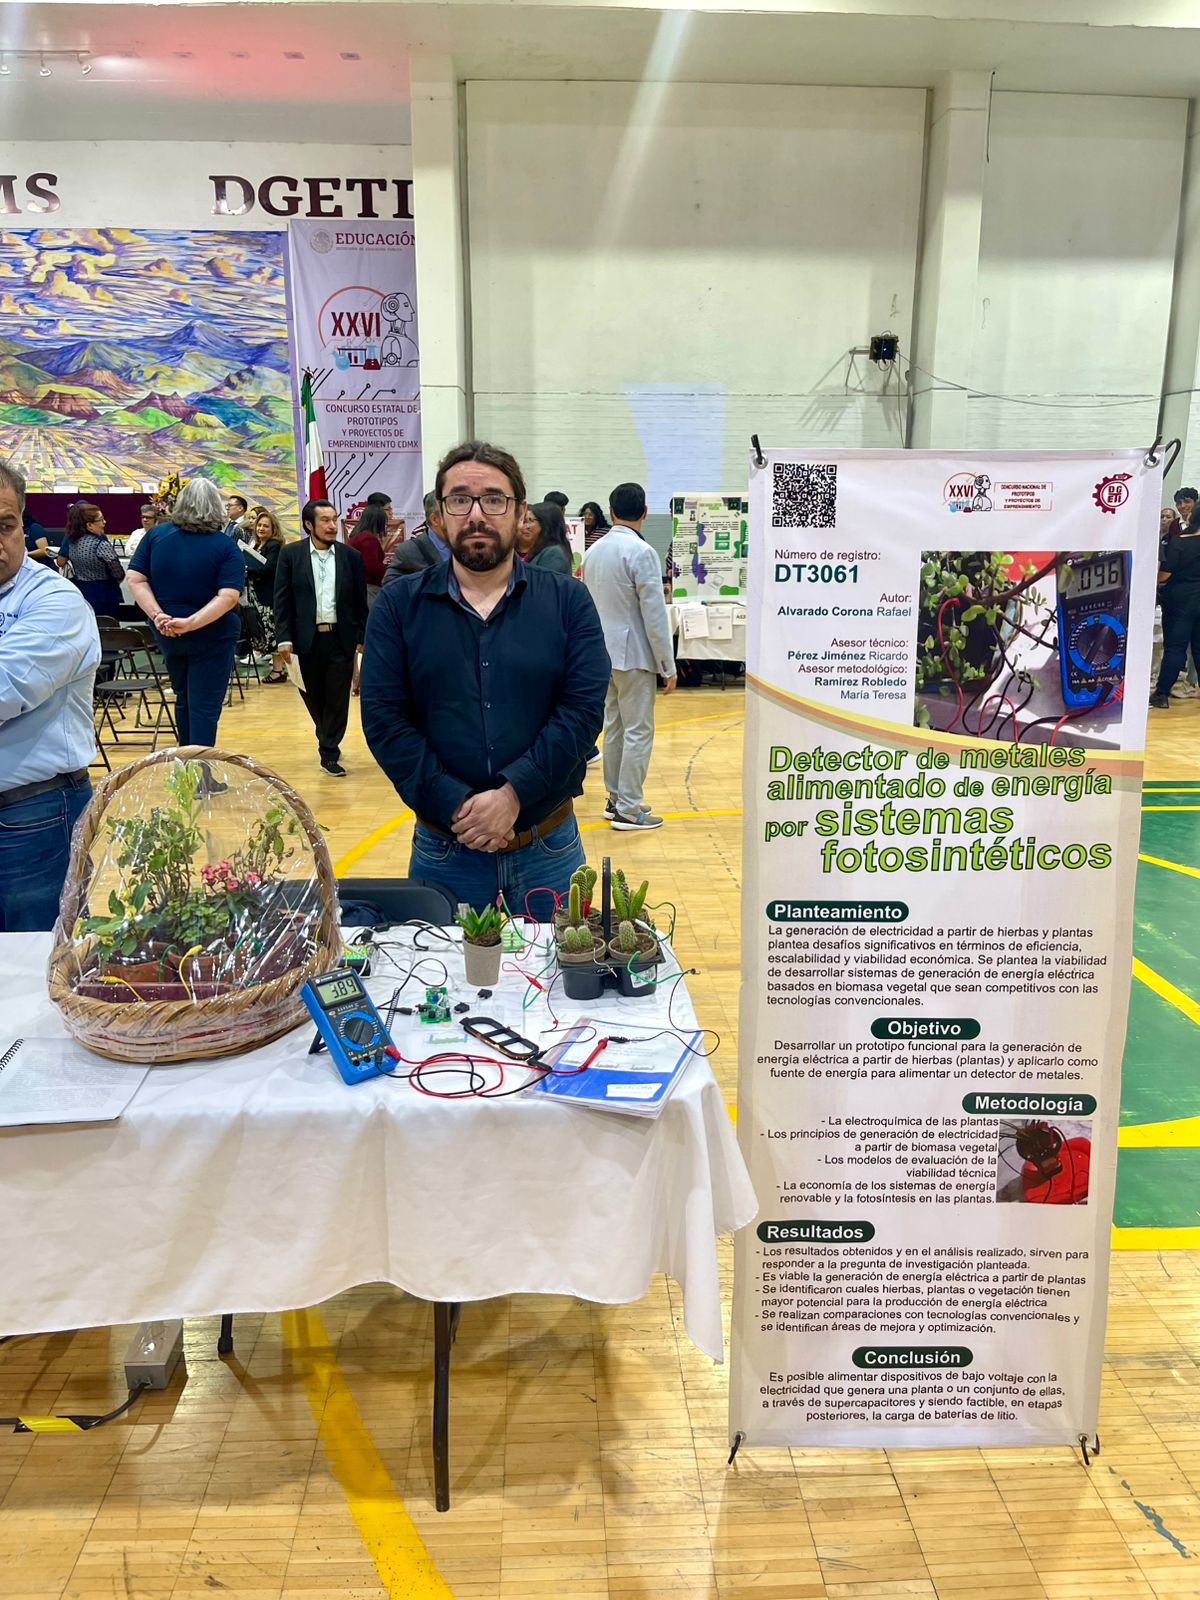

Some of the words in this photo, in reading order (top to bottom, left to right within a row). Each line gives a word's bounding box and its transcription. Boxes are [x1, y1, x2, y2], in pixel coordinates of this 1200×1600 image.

[209, 175, 414, 219] DGETI
[331, 312, 382, 337] XXVI
[326, 404, 370, 413] CONCURSO
[372, 404, 405, 413] ESTATAL
[407, 405, 417, 413] DE
[347, 417, 398, 425] PROTOTIPOS
[342, 428, 347, 436] Y
[348, 428, 392, 437] PROYECTOS
[394, 429, 404, 437] DE
[328, 440, 396, 448] EMPRENDIMIENTO
[397, 440, 418, 448] CDMX
[949, 485, 974, 498] XXVI
[774, 549, 816, 559] Número
[820, 550, 833, 560] de
[837, 550, 880, 562] registro:
[775, 564, 858, 583] DT3061
[879, 593, 911, 602] Autor:
[777, 606, 828, 616] Alvarado
[831, 606, 872, 616] Corona
[877, 606, 911, 616] Rafael
[831, 638, 866, 647] Asesor
[869, 638, 908, 647] técnico:
[788, 650, 818, 660] Pérez
[820, 650, 865, 660] Jiménez
[869, 651, 908, 660] Ricardo
[798, 664, 834, 673] Asesor
[837, 664, 907, 675] metodológico:
[862, 677, 906, 686] Robledo
[840, 690, 869, 699] María
[872, 690, 906, 699] Teresa
[770, 746, 908, 772] Detector
[916, 747, 950, 769] de
[960, 744, 1086, 769] metales
[767, 774, 946, 801] alimentado
[954, 777, 984, 797] de
[992, 769, 1112, 802] energía
[765, 818, 809, 842] por
[815, 801, 1014, 836] sistemas
[821, 837, 1112, 873] fotosintéticos
[774, 905, 903, 920] Planteamiento
[769, 925, 782, 935] La
[786, 925, 848, 937] generación
[852, 926, 866, 935] de
[869, 926, 933, 936] electricidad
[937, 928, 943, 936] a
[947, 926, 976, 938] partir
[979, 926, 993, 936] de
[997, 926, 1038, 937] hierbas
[1042, 929, 1049, 939] y
[1052, 927, 1093, 939] plantas
[768, 939, 809, 951] plantea
[812, 939, 860, 949] desafíos
[864, 939, 936, 952] significativos
[939, 942, 953, 950] en
[956, 940, 1005, 950] términos
[1008, 941, 1022, 951] de
[1026, 941, 1081, 952] eficiencia,
[767, 995, 830, 1007] tecnologías
[834, 995, 923, 1005] convencionales.
[888, 1021, 961, 1038] Objetivo
[774, 1040, 835, 1050] Desarrollar
[839, 1042, 852, 1050] un
[856, 1041, 904, 1052] prototipo
[908, 1040, 957, 1051] funcional
[961, 1043, 985, 1053] para
[989, 1042, 998, 1051] la
[1002, 1042, 1064, 1053] generación
[1067, 1043, 1081, 1052] de
[770, 1067, 804, 1077] fuente
[808, 1068, 822, 1077] de
[825, 1068, 867, 1080] energía
[871, 1070, 895, 1080] para
[899, 1068, 950, 1078] alimentar
[953, 1070, 967, 1078] un
[970, 1068, 1016, 1078] detector
[1018, 1069, 1033, 1079] de
[1036, 1070, 1083, 1079] metales.
[976, 1096, 1082, 1114] Metodología
[864, 1142, 892, 1153] partir
[894, 1142, 908, 1151] de
[911, 1142, 956, 1151] biomasa
[959, 1143, 998, 1154] vegetal
[906, 1168, 955, 1177] viabilidad
[959, 1168, 997, 1178] técnica
[780, 1193, 831, 1203] renovable
[835, 1196, 840, 1205] y
[844, 1193, 853, 1203] la
[856, 1193, 915, 1203] fotosíntesis
[919, 1195, 932, 1203] en
[935, 1194, 950, 1203] las
[954, 1194, 995, 1205] plantas.
[767, 1225, 864, 1239] Resultados
[762, 1259, 815, 1269] responder
[828, 1260, 836, 1268] la
[840, 1259, 886, 1270] pregunta
[888, 1259, 902, 1268] de
[905, 1259, 973, 1271] investigación
[976, 1260, 1029, 1271] planteada.
[761, 1298, 794, 1307] mayor
[797, 1297, 843, 1308] potencial
[846, 1298, 869, 1307] para
[873, 1297, 882, 1306] la
[885, 1297, 942, 1308] producción
[945, 1297, 958, 1306] de
[961, 1299, 1001, 1310] energía
[1005, 1298, 1047, 1308] eléctrica
[776, 1322, 828, 1332] identifican
[831, 1322, 860, 1331] áreas
[864, 1322, 876, 1331] de
[880, 1322, 915, 1333] mejora
[918, 1324, 924, 1333] y
[928, 1322, 995, 1333] optimización.
[864, 1350, 961, 1364] Conclusión
[769, 1372, 783, 1382] Es
[787, 1371, 824, 1383] posible
[827, 1371, 878, 1381] alimentar
[880, 1371, 942, 1383] dispositivos
[945, 1371, 958, 1380] de
[962, 1371, 985, 1382] bajo
[988, 1372, 1023, 1384] voltaje
[1027, 1375, 1045, 1383] con
[1048, 1372, 1057, 1381] la
[760, 1384, 820, 1395] electricidad
[823, 1386, 843, 1396] que
[847, 1387, 884, 1397] genera
[911, 1384, 943, 1396] planta
[956, 1386, 970, 1394] un
[973, 1385, 1019, 1396] conjunto
[1022, 1387, 1036, 1396] de
[1039, 1386, 1064, 1396] ellas,
[806, 1411, 868, 1422] posteriores,
[872, 1411, 881, 1420] la
[885, 1412, 914, 1422] carga
[918, 1410, 931, 1420] de
[934, 1410, 977, 1419] baterías
[980, 1411, 994, 1420] de
[997, 1411, 1017, 1420] litio.
